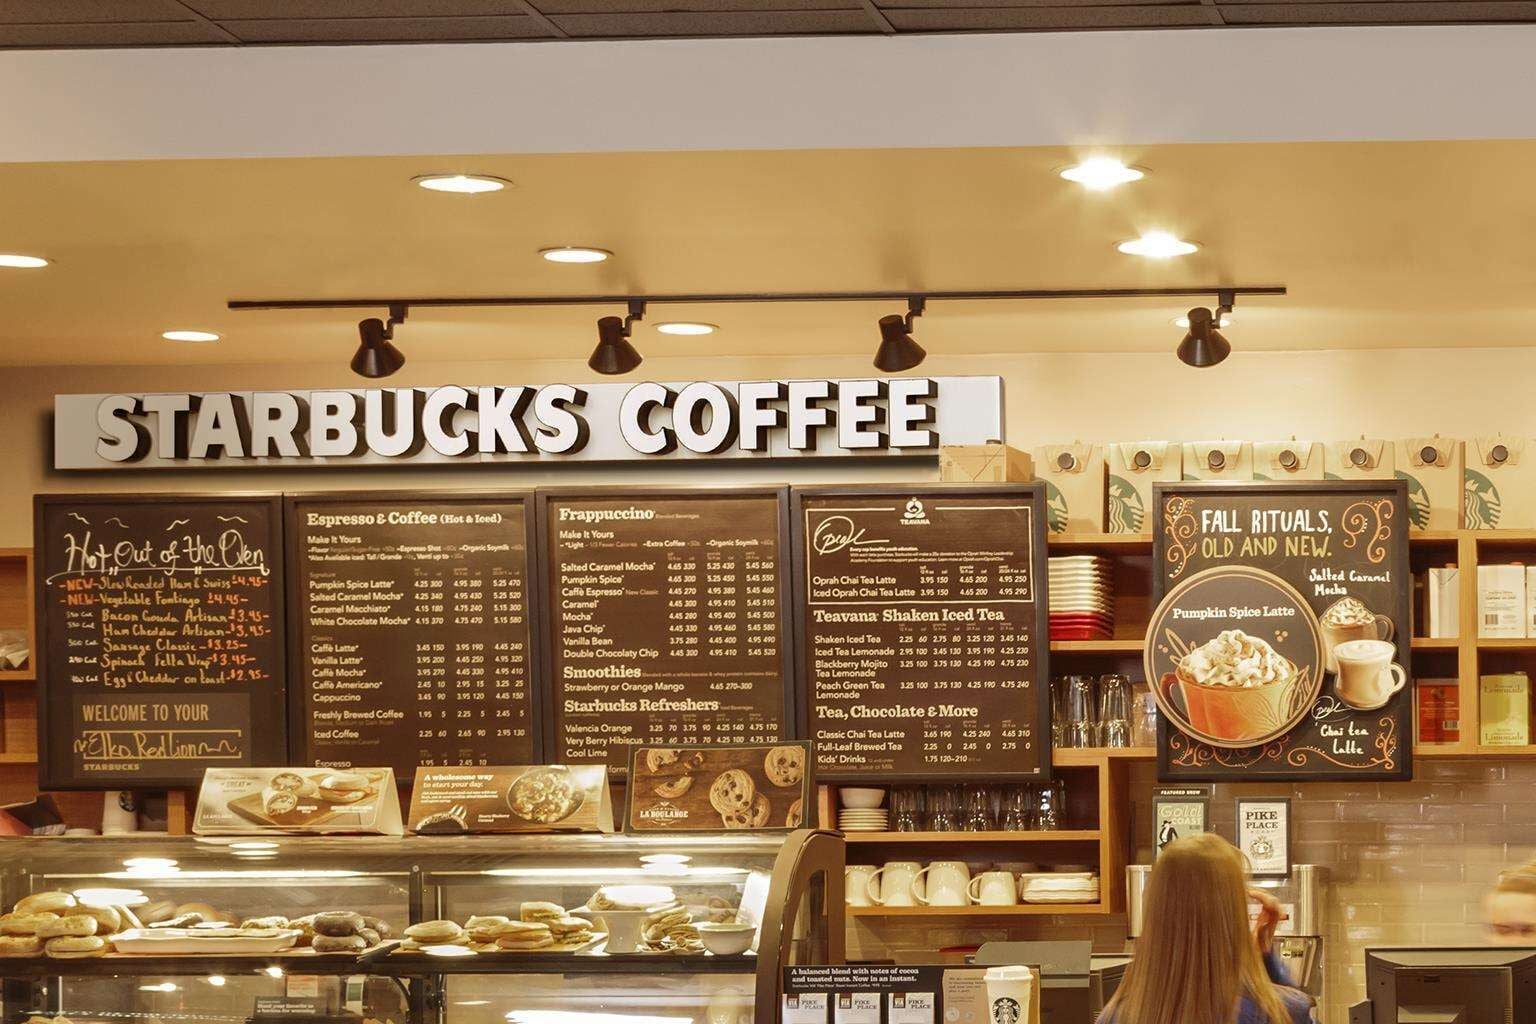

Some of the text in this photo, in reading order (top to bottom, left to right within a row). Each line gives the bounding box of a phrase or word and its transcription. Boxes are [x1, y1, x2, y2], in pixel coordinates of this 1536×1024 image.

[96, 380, 928, 462] STARBUCKS COFFEE
[307, 512, 502, 527] Espresso & Coffee (Hot & Iced)
[1202, 510, 1332, 534] FALL RITUALS,
[64, 530, 264, 576] Hot Out of the Oven
[1202, 536, 1332, 558] OLD AND NEW.
[1310, 569, 1390, 582] Salted Caramel
[1315, 584, 1347, 596] Mocha
[102, 610, 227, 623] Bacon Gouda Artisan
[814, 608, 1004, 623] Teavana Shaken Iced Tea
[1173, 606, 1295, 620] Pumpkin Spice Latte
[103, 624, 224, 636] Ham Cheddar Artisan
[103, 638, 196, 652] Sausage Classic
[563, 637, 612, 646] Vanilla Bean
[564, 649, 658, 659] Double Chocolaty Chip
[564, 665, 641, 678] Smoothies
[565, 683, 608, 692] Strawberry
[622, 683, 653, 692] Orange
[655, 683, 684, 692] Mango
[313, 694, 361, 703] Cappuccino
[565, 700, 637, 712] Starbucks
[816, 705, 978, 720] Tea, Chocolate & More
[83, 704, 209, 722] WELCOME TO YOUR
[314, 710, 404, 720] Freshly Brewed Coffee
[314, 730, 359, 738] Iced Coffee
[566, 724, 632, 734] Valencia Orange
[817, 731, 845, 739] Classic
[884, 730, 905, 738] Latte
[1320, 721, 1369, 736] Chai tea
[134, 732, 165, 759] Red
[169, 732, 198, 758] Lion
[1332, 738, 1364, 754] Latte
[566, 749, 607, 757] Cool Lime
[477, 774, 494, 782] way
[1247, 812, 1278, 820] PIKE
